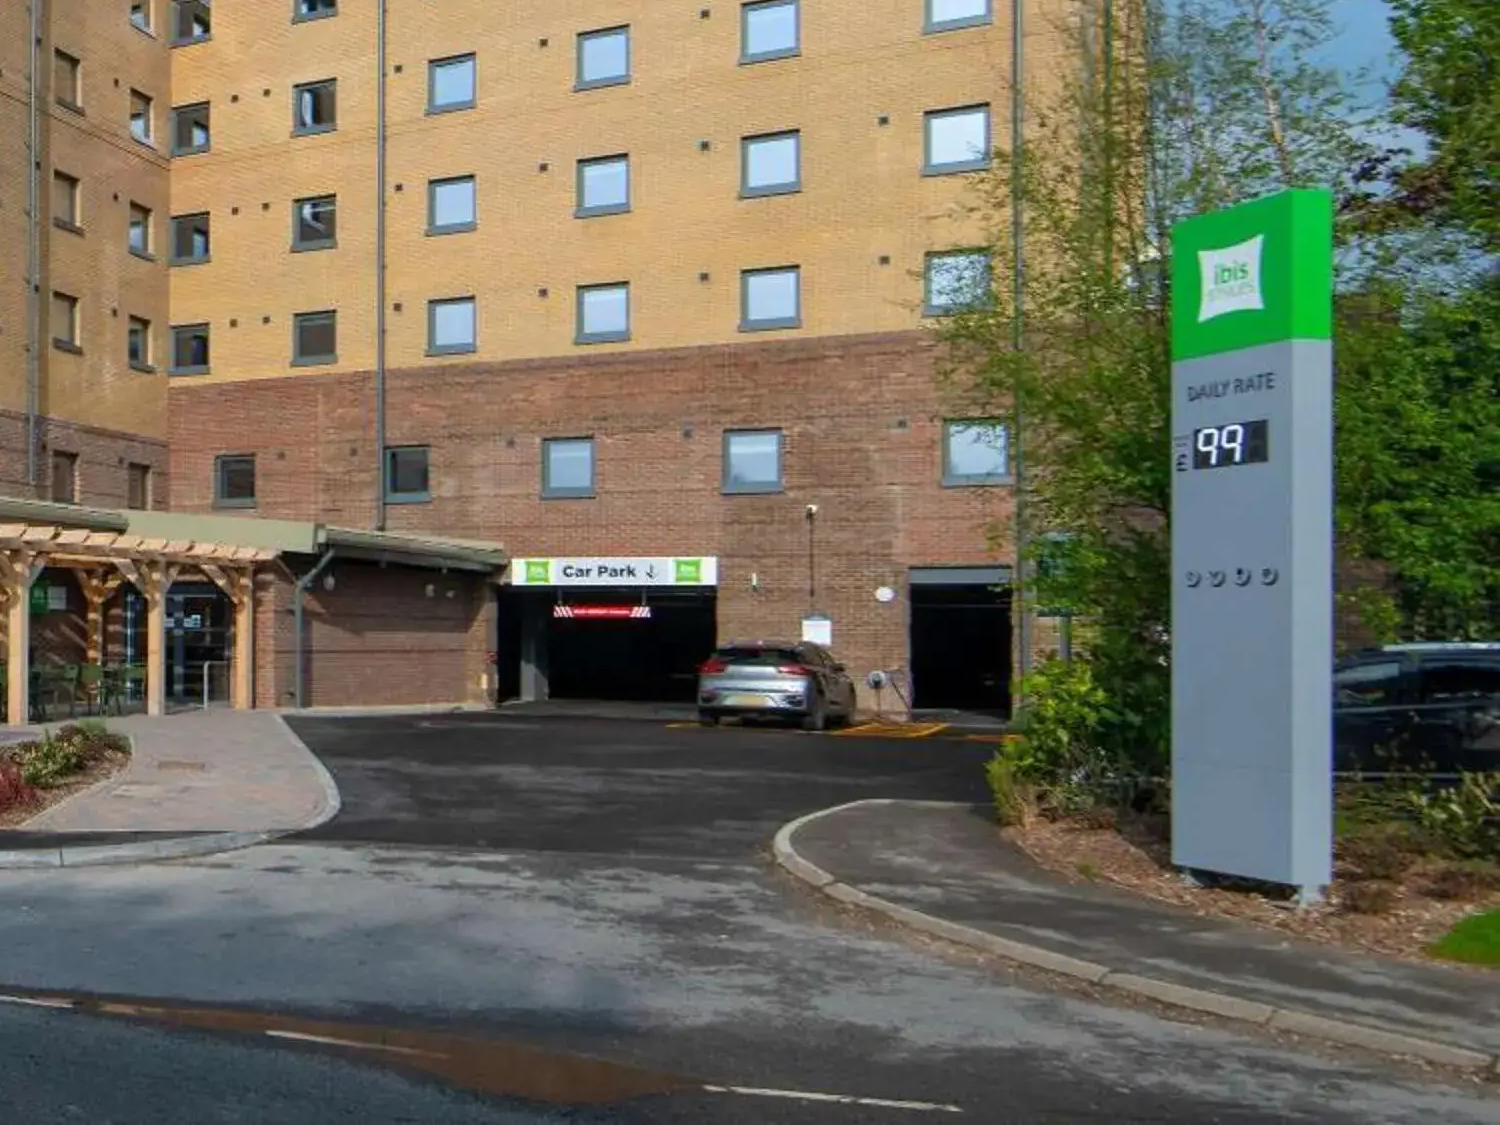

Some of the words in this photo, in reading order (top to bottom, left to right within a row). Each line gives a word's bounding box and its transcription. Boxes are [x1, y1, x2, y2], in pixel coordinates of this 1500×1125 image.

[1213, 260, 1249, 286] ibis
[1186, 378, 1231, 402] DAILY
[1232, 372, 1276, 395] RATE
[1197, 425, 1244, 466] 99
[562, 565, 592, 579] Car
[597, 565, 637, 579] Park
